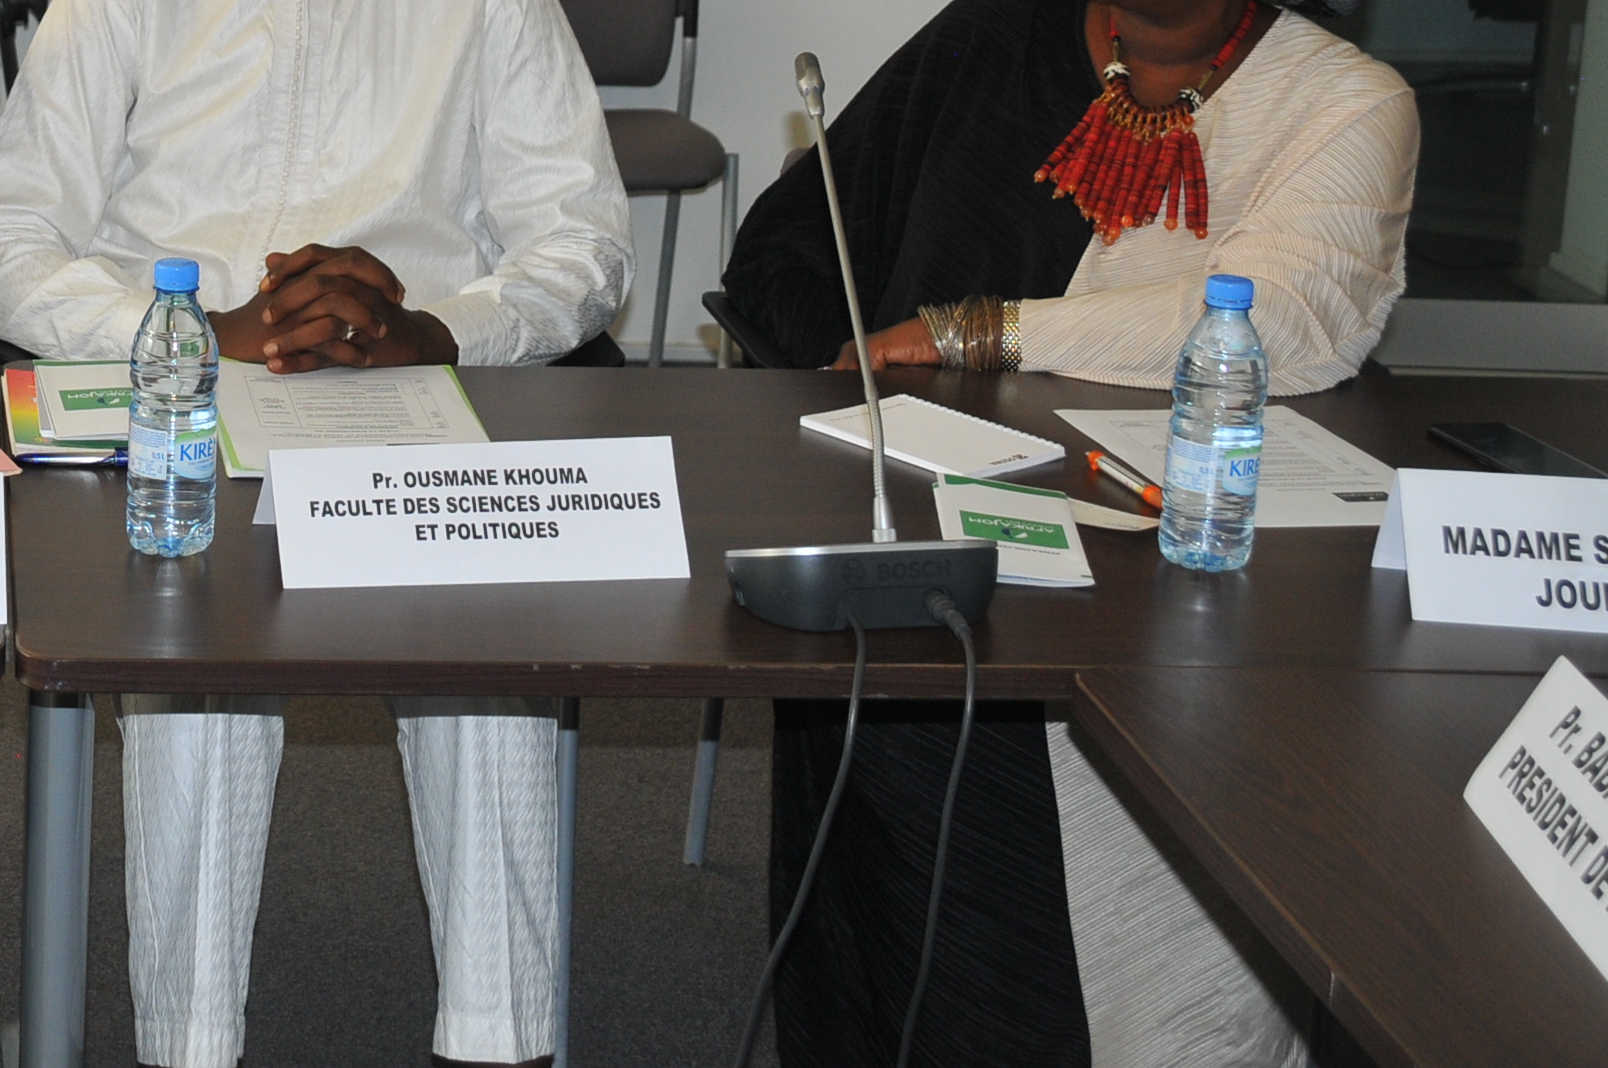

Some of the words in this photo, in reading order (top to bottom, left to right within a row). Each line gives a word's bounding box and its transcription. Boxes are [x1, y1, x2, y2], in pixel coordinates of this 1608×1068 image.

[371, 472, 398, 489] Pr.
[403, 469, 499, 488] OUSMANE
[503, 467, 589, 486] KHOUMA
[309, 499, 398, 517] FACULTE
[403, 497, 441, 515] DES
[446, 494, 541, 514] SCIENCES
[546, 491, 662, 512] JURIDIQUES
[415, 524, 439, 541] ET
[444, 520, 560, 540] POLITIQUES
[1442, 525, 1583, 562] MADAME
[1593, 534, 1608, 564] S
[1535, 578, 1608, 612] JOU
[1498, 744, 1599, 868] PRESIDENT
